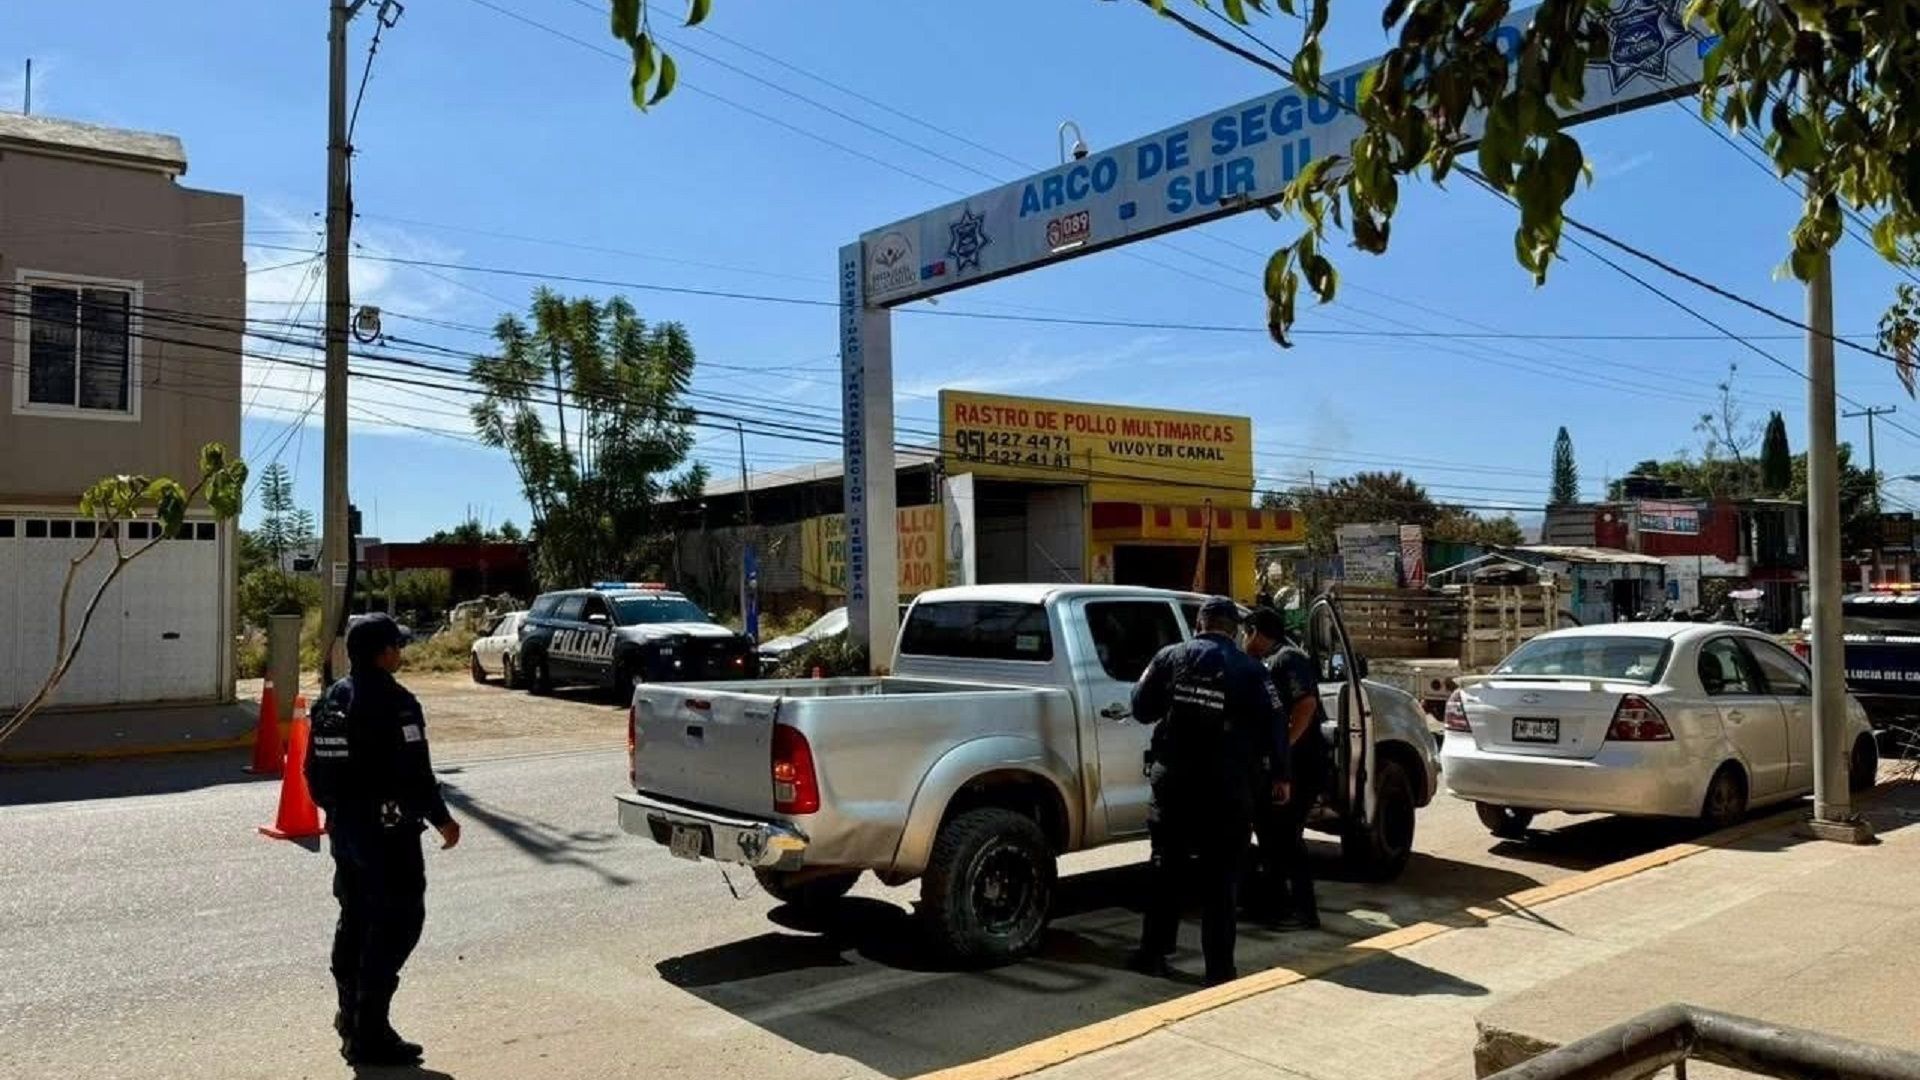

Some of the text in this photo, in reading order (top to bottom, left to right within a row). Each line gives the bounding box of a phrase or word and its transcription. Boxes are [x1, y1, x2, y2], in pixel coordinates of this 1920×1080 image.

[1019, 154, 1117, 218] ARCO
[1137, 130, 1190, 181] DE
[1166, 156, 1255, 214] SUR
[1063, 212, 1089, 235] 089
[955, 403, 1233, 443] RASTRO DE POLLO MULTIMARCAS
[955, 428, 986, 458] 951
[987, 431, 1021, 447] 427
[1108, 441, 1145, 457] VIVO
[1177, 445, 1225, 461] CANAL
[548, 629, 617, 656] POLICIA
[1851, 669, 1882, 680] LUCIA
[1884, 670, 1903, 680] DEL
